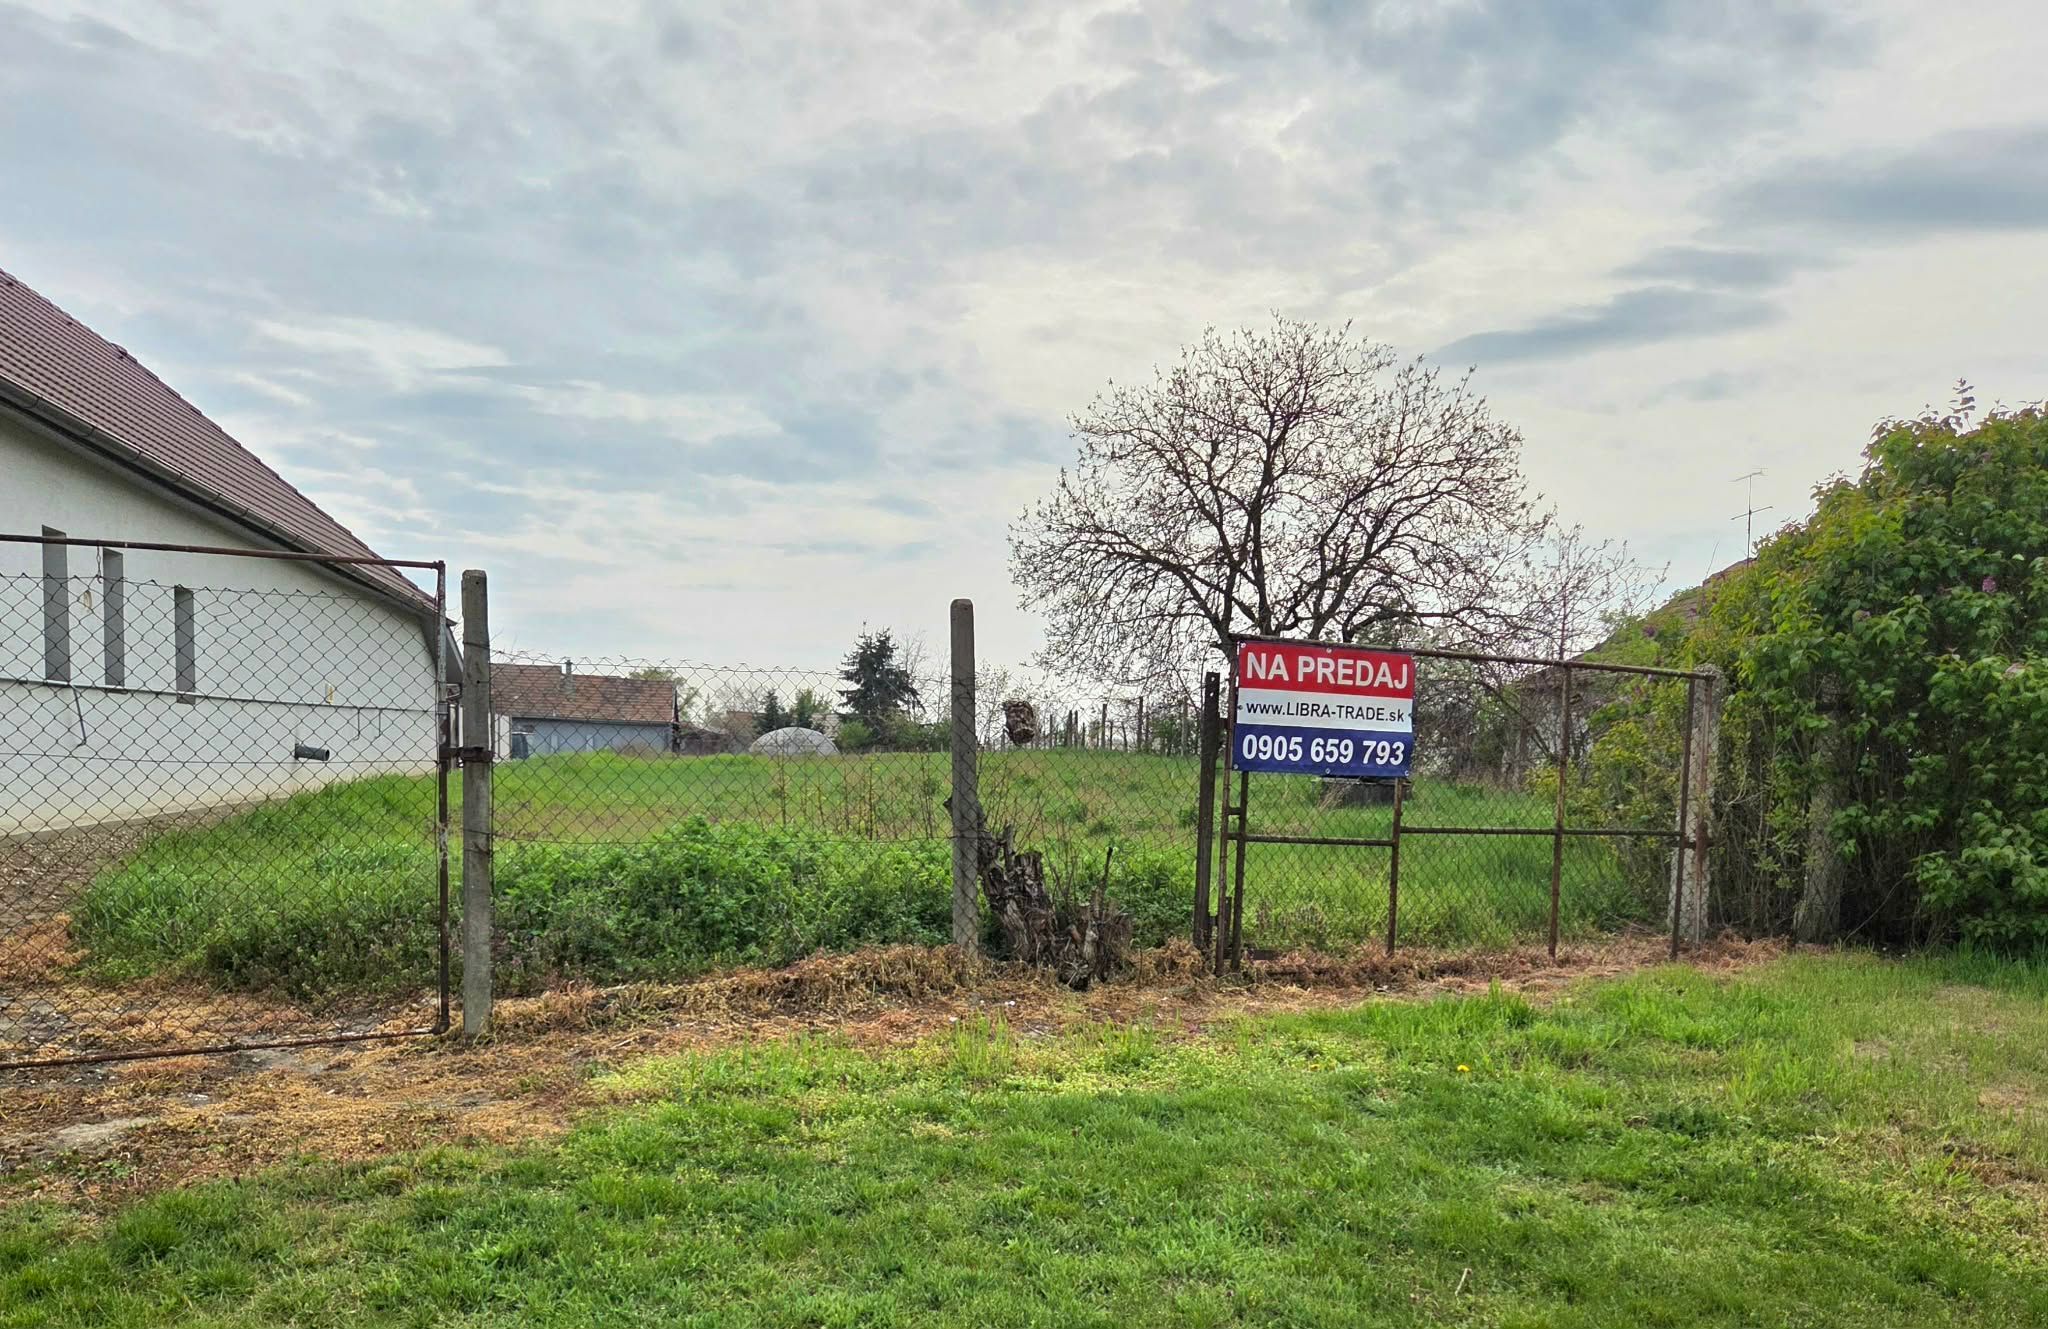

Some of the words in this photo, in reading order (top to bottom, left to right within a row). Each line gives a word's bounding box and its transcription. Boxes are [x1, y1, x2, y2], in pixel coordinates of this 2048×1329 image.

[1246, 652, 1289, 681] NA
[1297, 655, 1408, 689] PREDAJ
[1246, 702, 1405, 722] www.LIBRA-TRADE.sk
[1242, 734, 1303, 762] 0905
[1310, 737, 1354, 764] 659
[1362, 740, 1405, 766] 793
